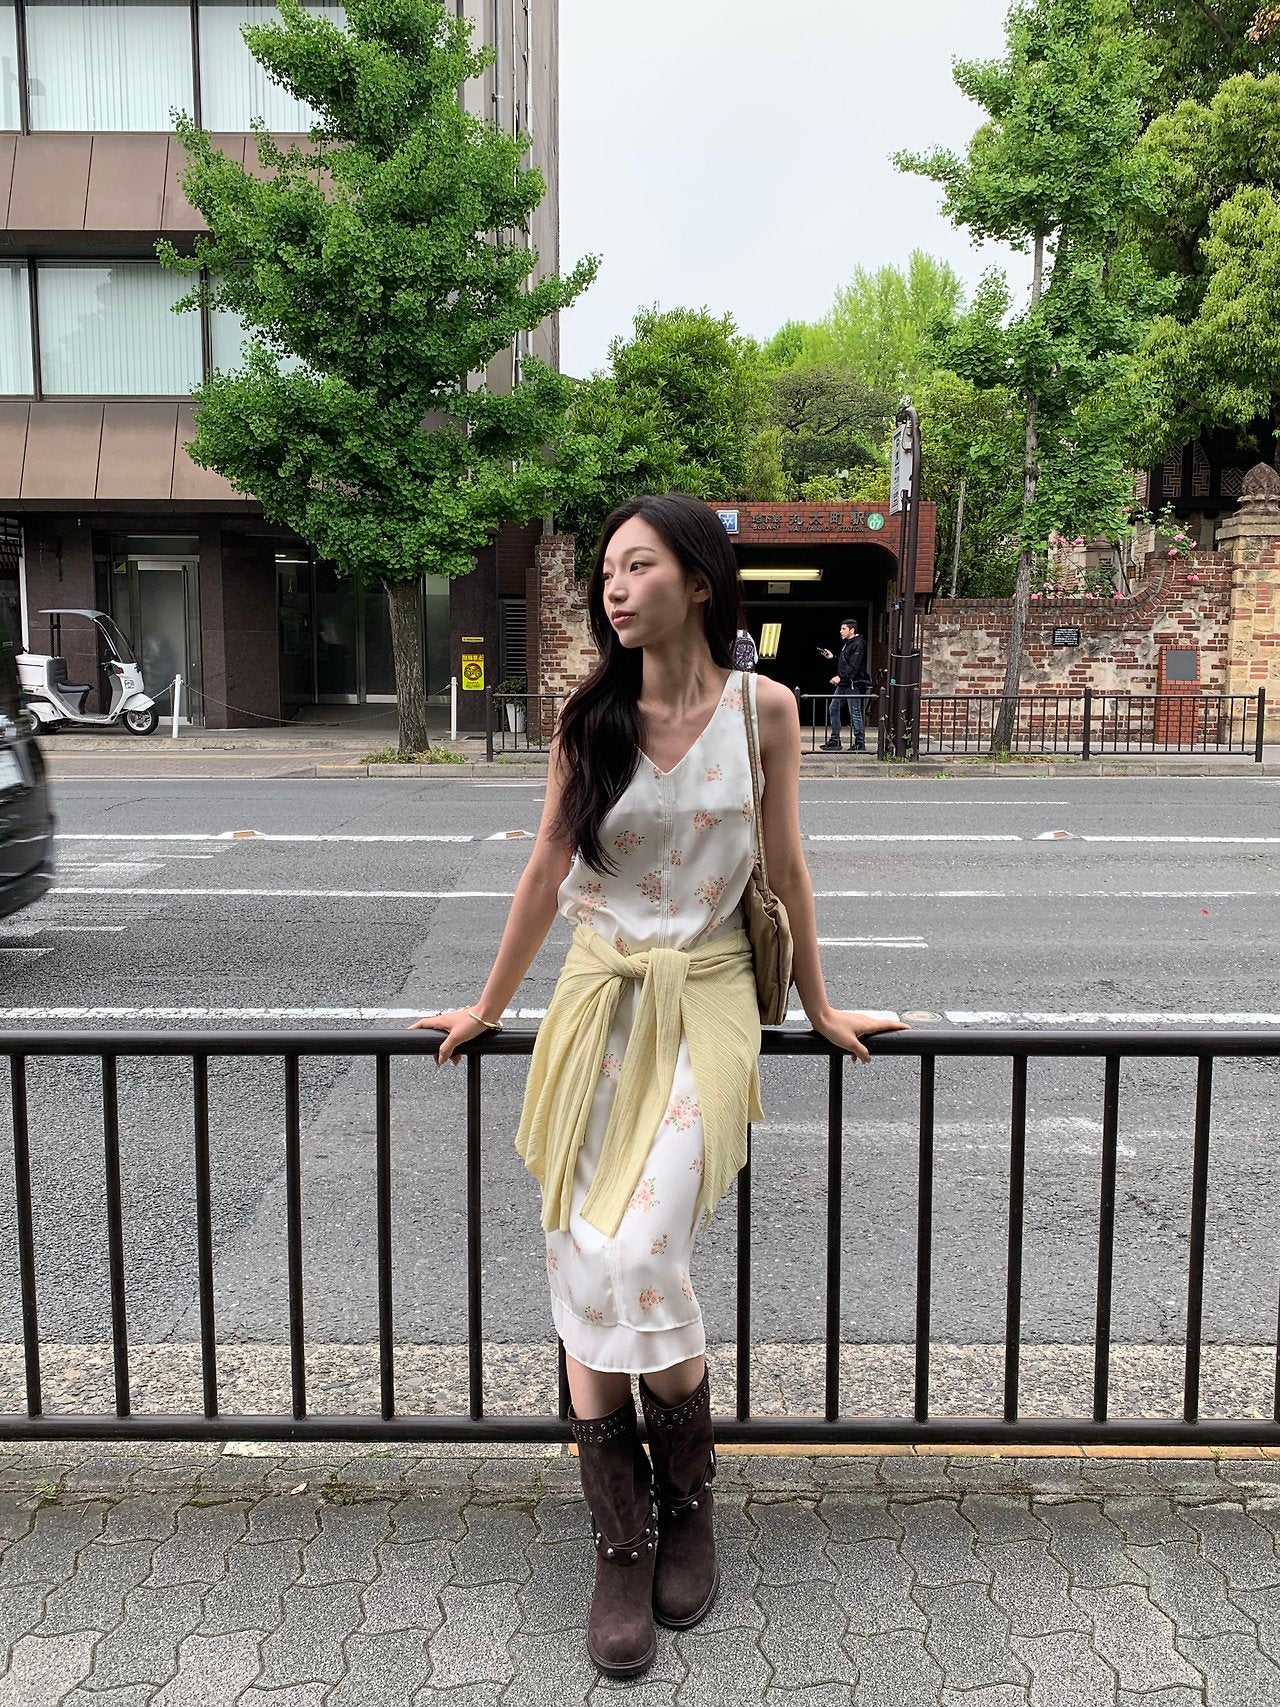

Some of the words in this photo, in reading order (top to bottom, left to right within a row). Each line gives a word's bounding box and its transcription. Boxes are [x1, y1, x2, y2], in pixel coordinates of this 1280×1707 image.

[789, 511, 865, 525] 丸太町駅
[752, 523, 781, 531] SUBWAY
[870, 520, 881, 530] 07
